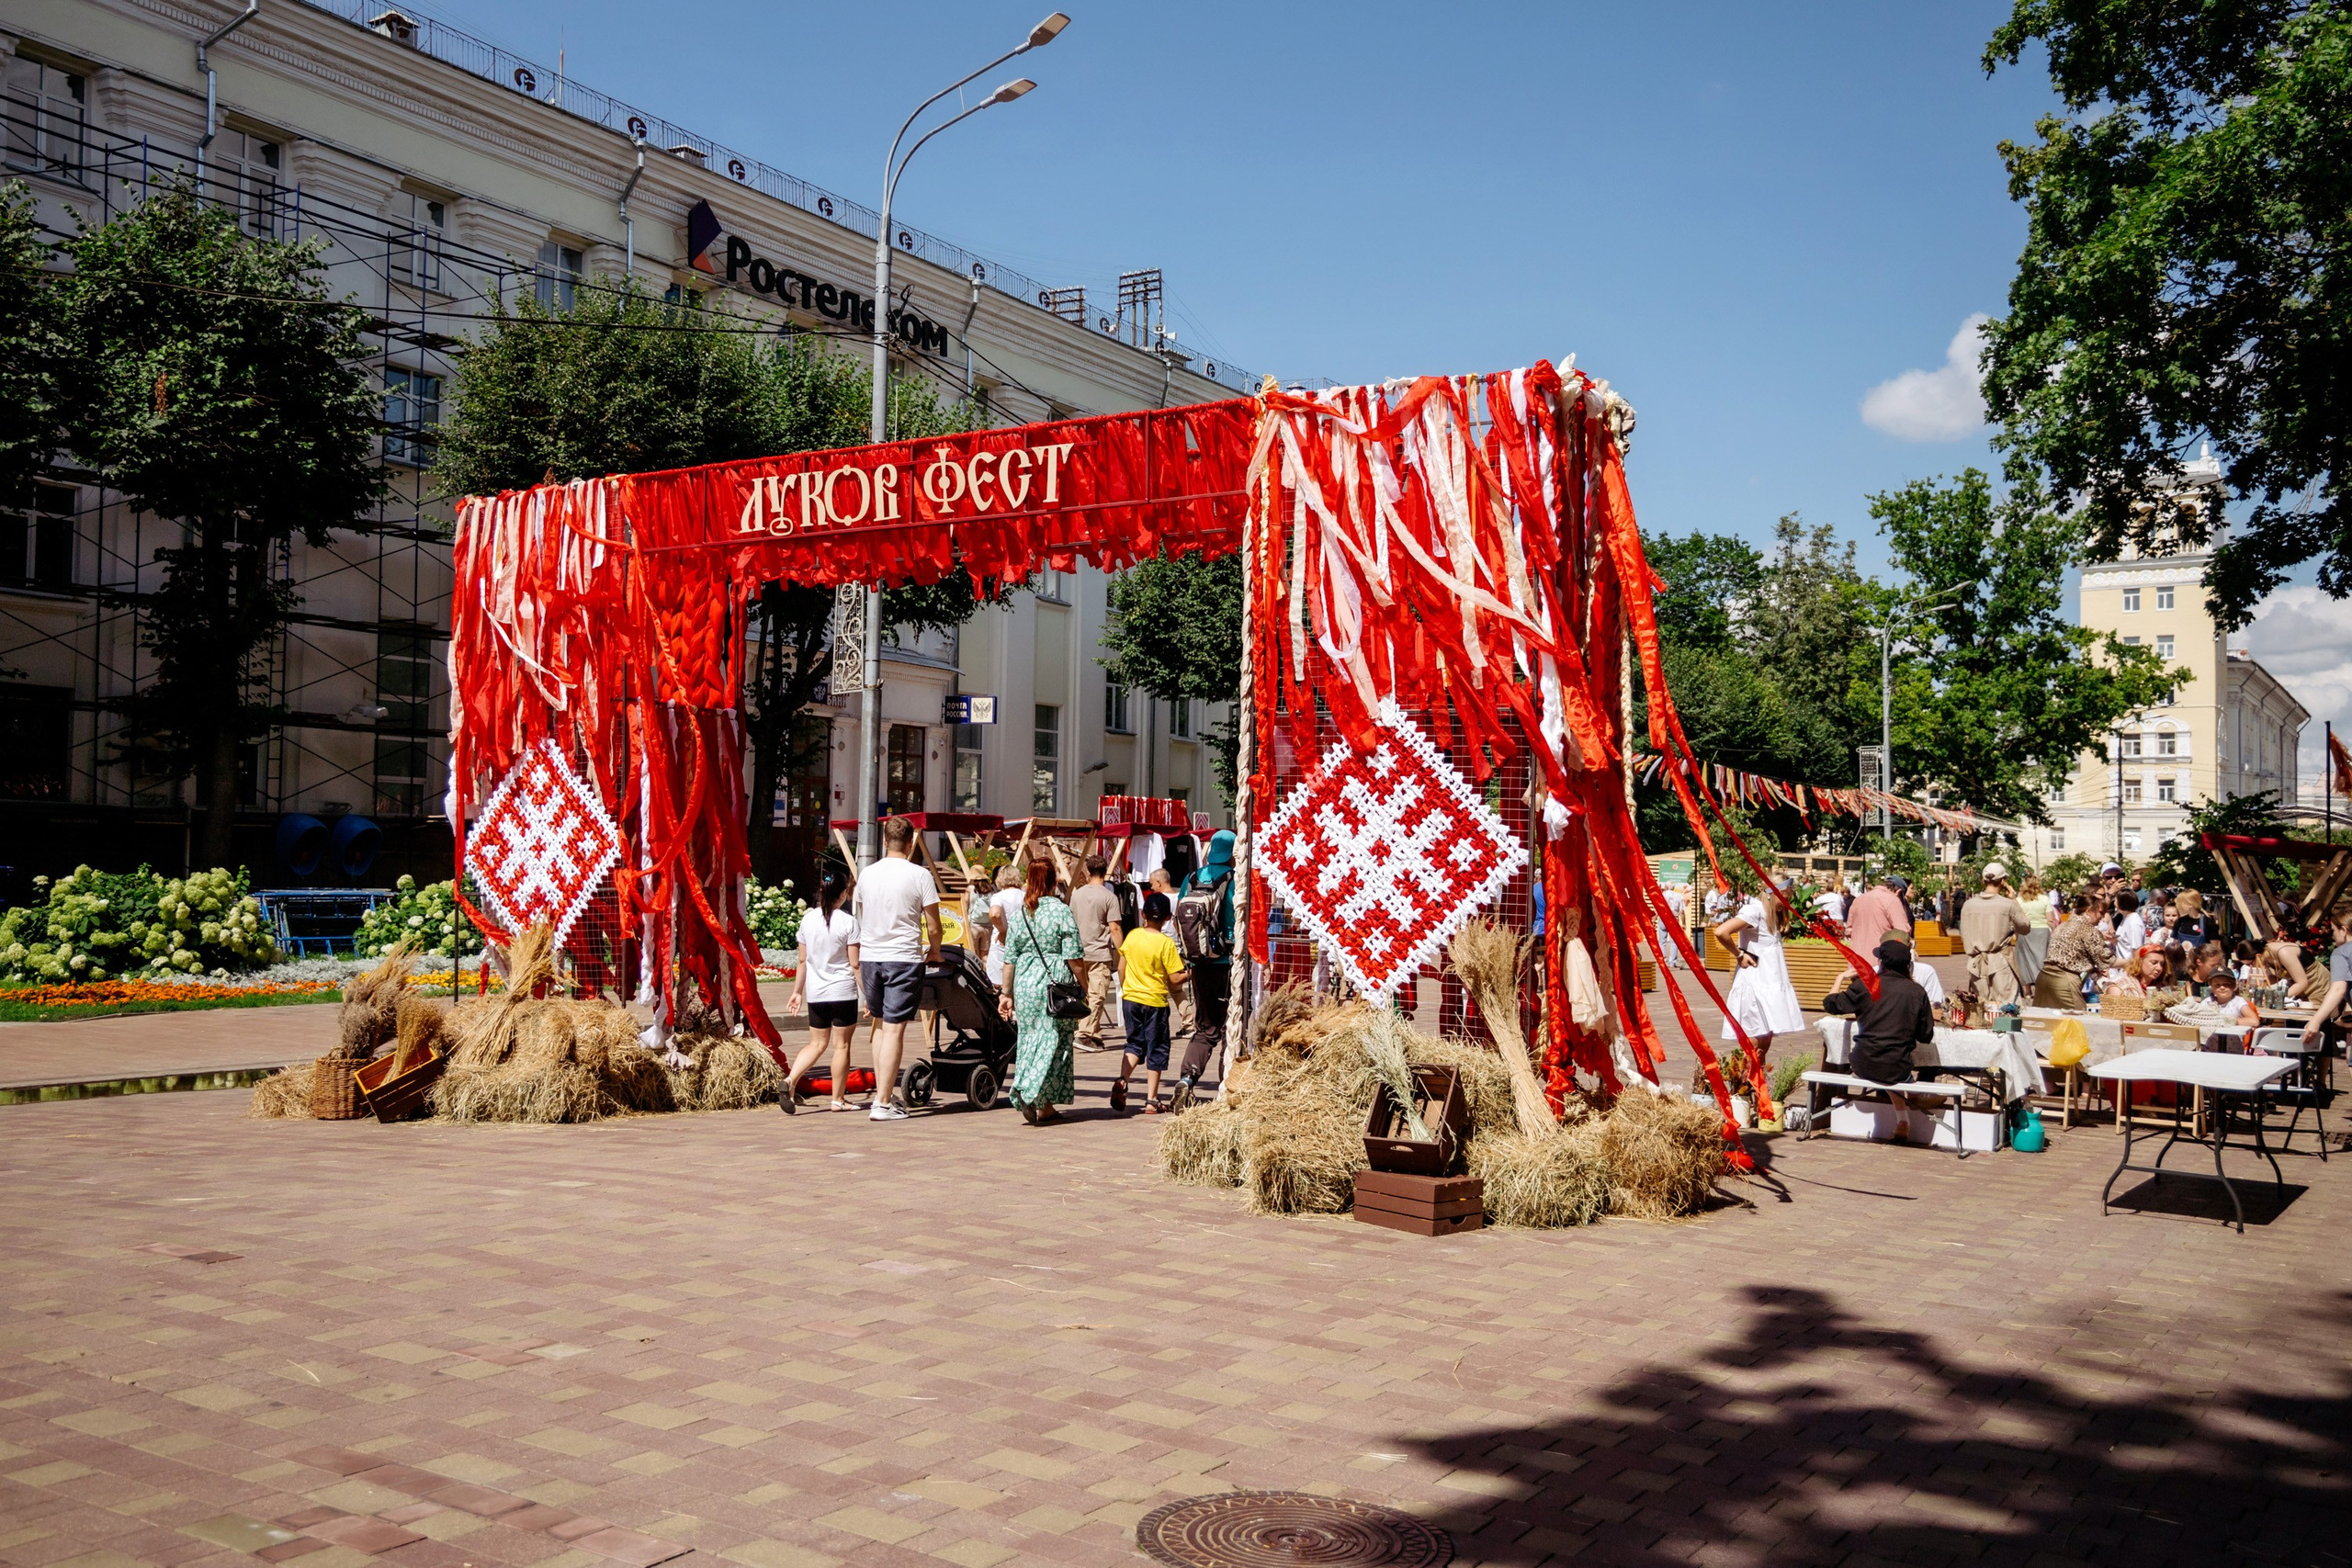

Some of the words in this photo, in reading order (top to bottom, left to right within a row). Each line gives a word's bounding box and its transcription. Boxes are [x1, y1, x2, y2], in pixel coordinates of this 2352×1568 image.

[923, 443, 1074, 513] ФЕСТ
[946, 702, 967, 710] ПОЧТА
[946, 710, 967, 718] РОССИИ
